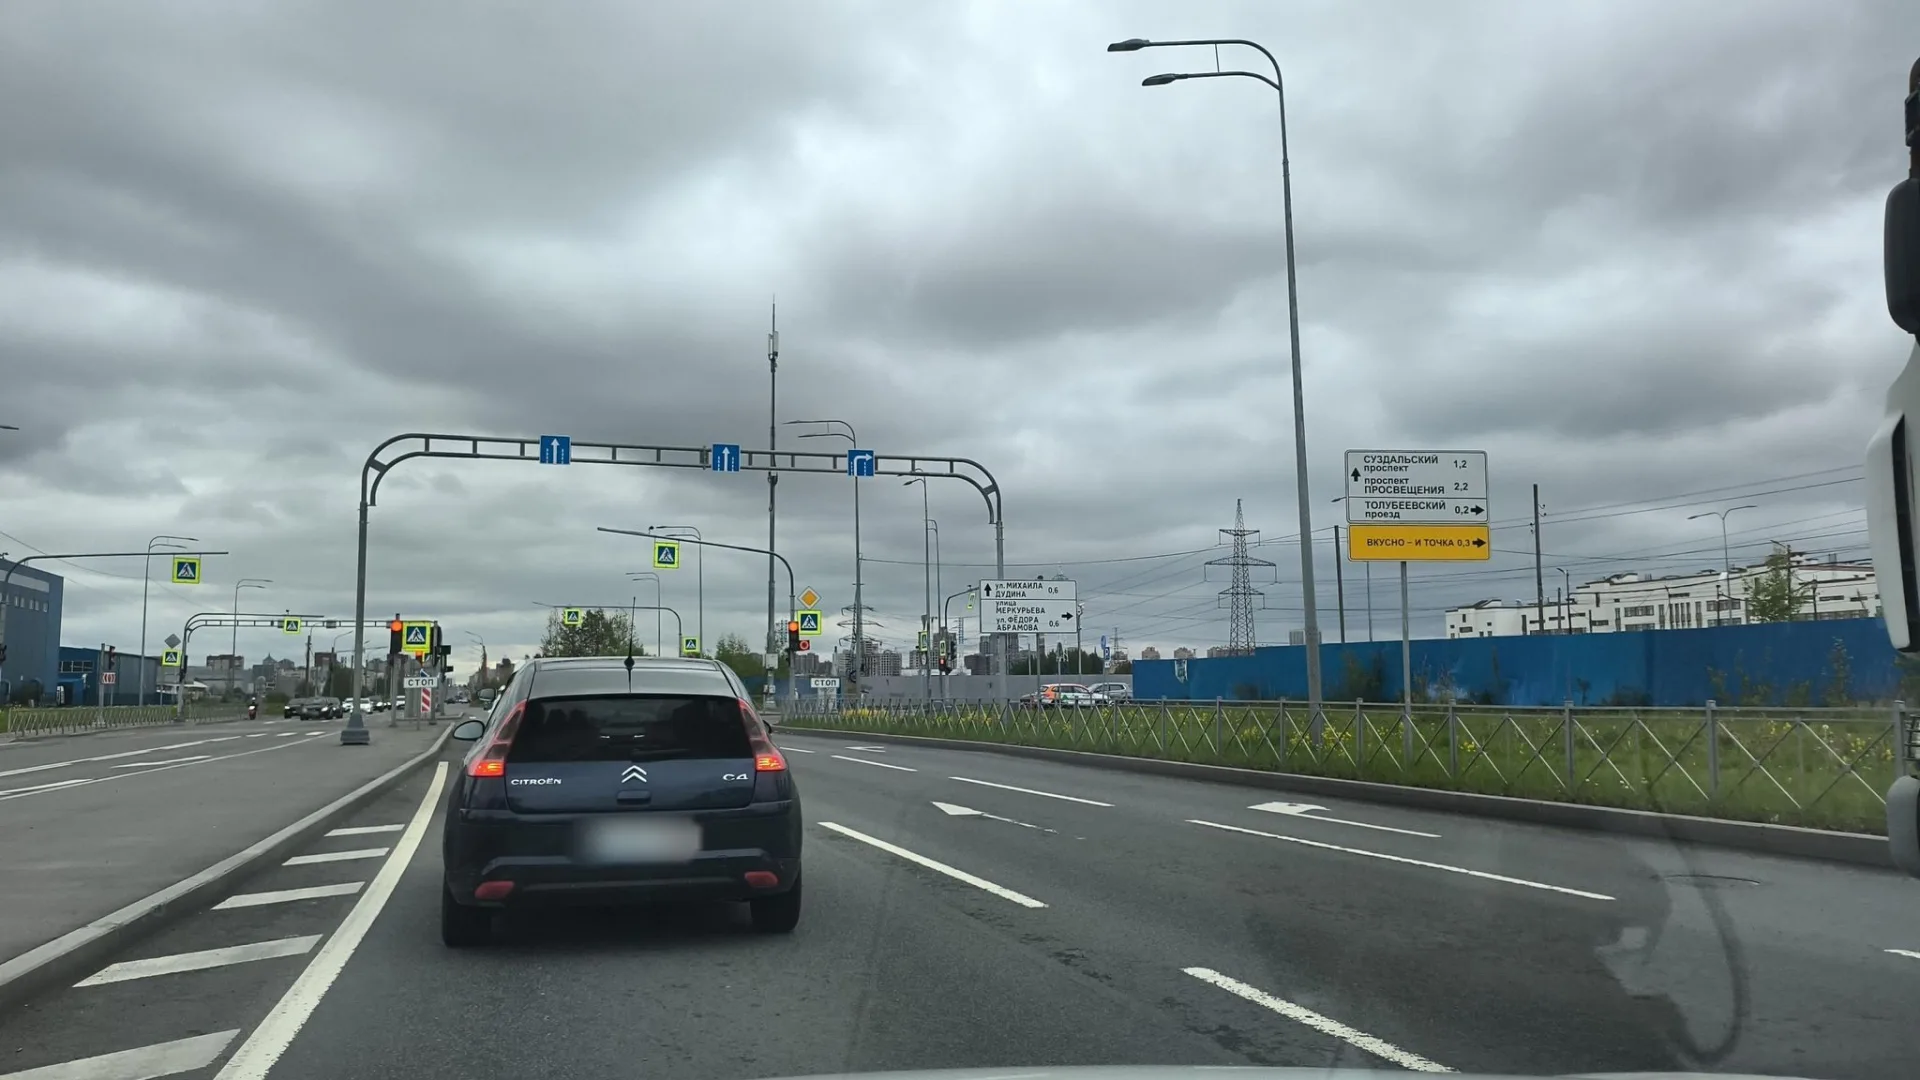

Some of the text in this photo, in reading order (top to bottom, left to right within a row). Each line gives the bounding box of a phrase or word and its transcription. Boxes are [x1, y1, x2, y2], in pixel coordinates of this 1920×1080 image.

[1364, 454, 1438, 464] СУЗДАЛЬСКИЙ
[1364, 464, 1408, 472] проспект
[1454, 460, 1467, 469] 1,2
[1364, 477, 1409, 485] проспект
[1364, 486, 1444, 495] ПРОСВЕЩЕНИЯ
[1454, 482, 1468, 492] 2,2
[1365, 500, 1446, 510] ТОЛУБЕЕВСКИЙ
[1454, 506, 1469, 514] 0,2
[1365, 511, 1400, 519] проезд
[1366, 538, 1404, 546] ВКУСНО
[1425, 538, 1454, 546] ТОЧКА
[1457, 538, 1470, 548] 0,3
[1008, 615, 1039, 624] ФЁДОРА
[510, 778, 562, 786] CITROËN
